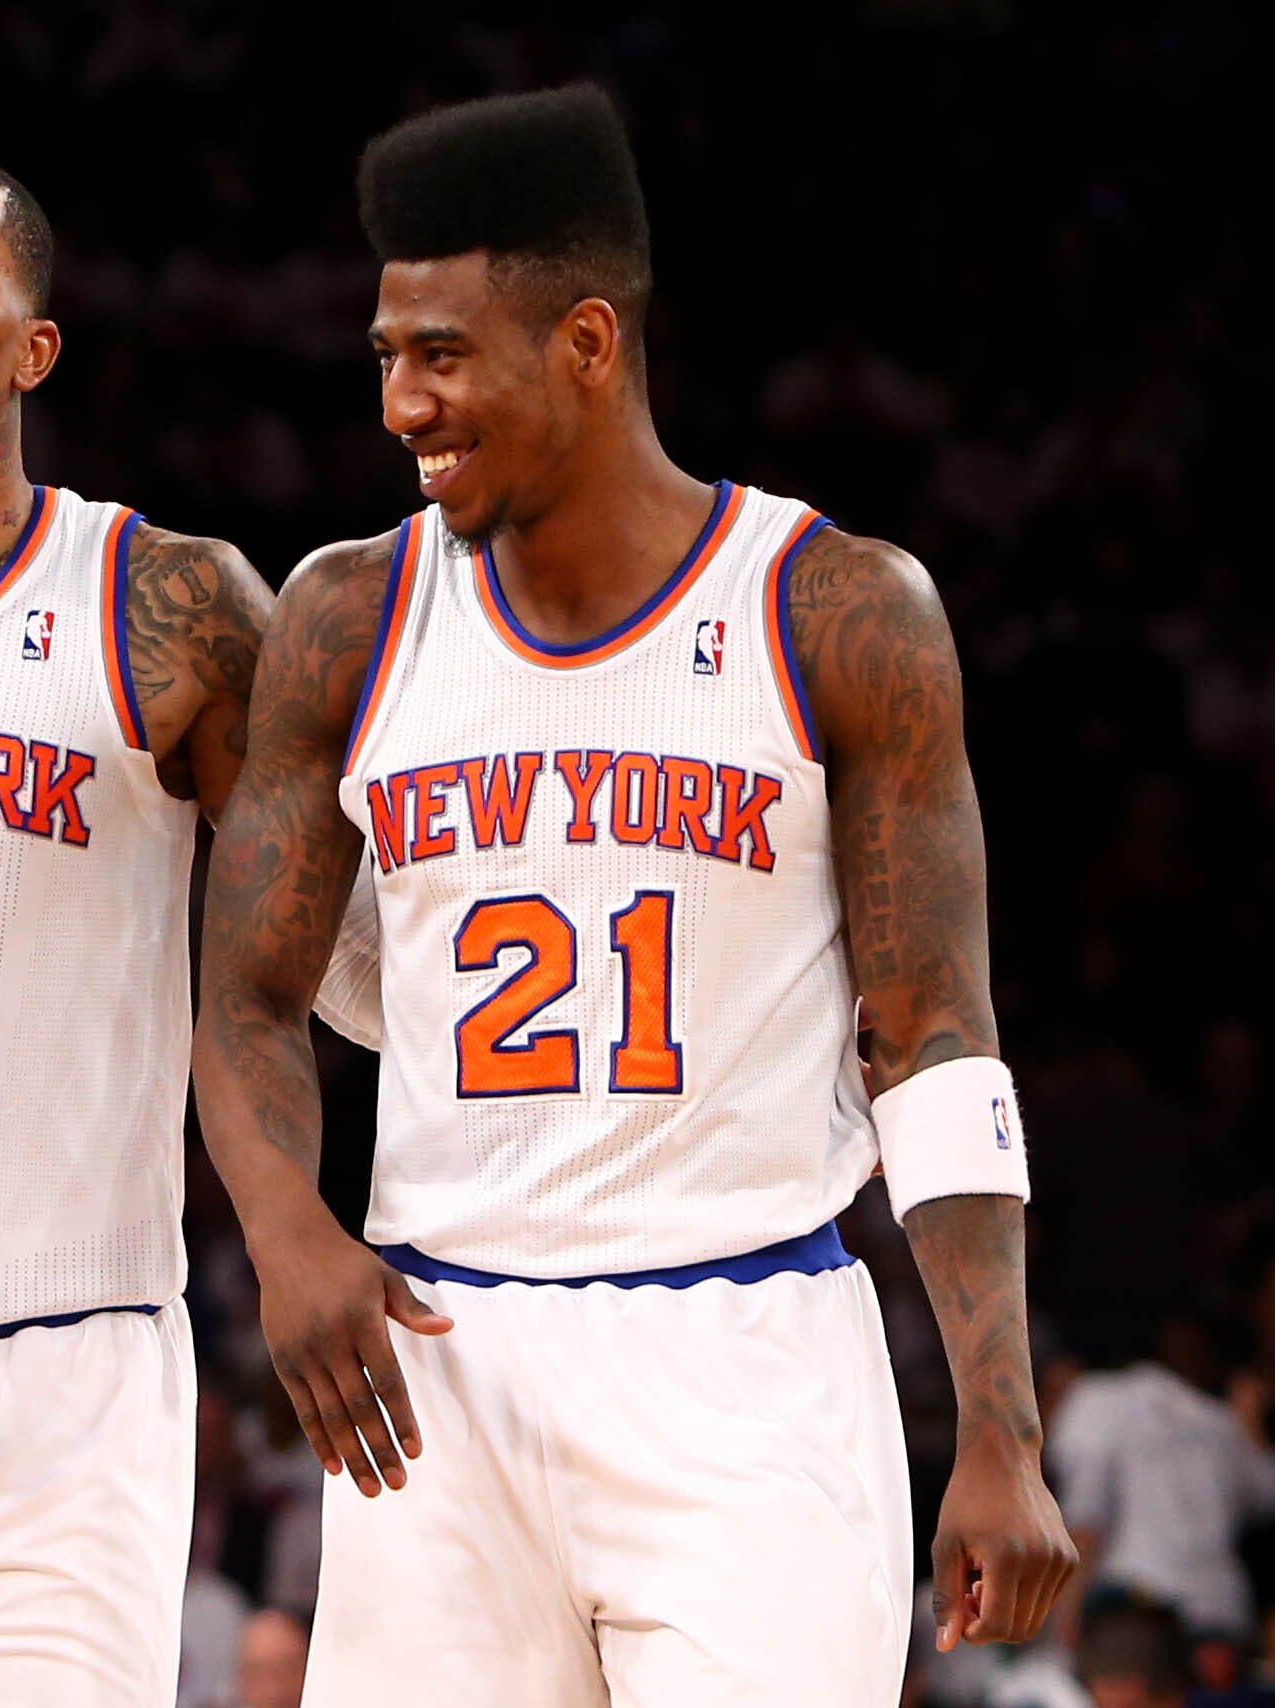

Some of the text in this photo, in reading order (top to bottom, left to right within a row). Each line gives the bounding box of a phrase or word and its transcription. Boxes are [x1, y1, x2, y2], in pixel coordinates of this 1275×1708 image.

[366, 749, 783, 874] NEW YORK
[453, 889, 685, 1099] 21
